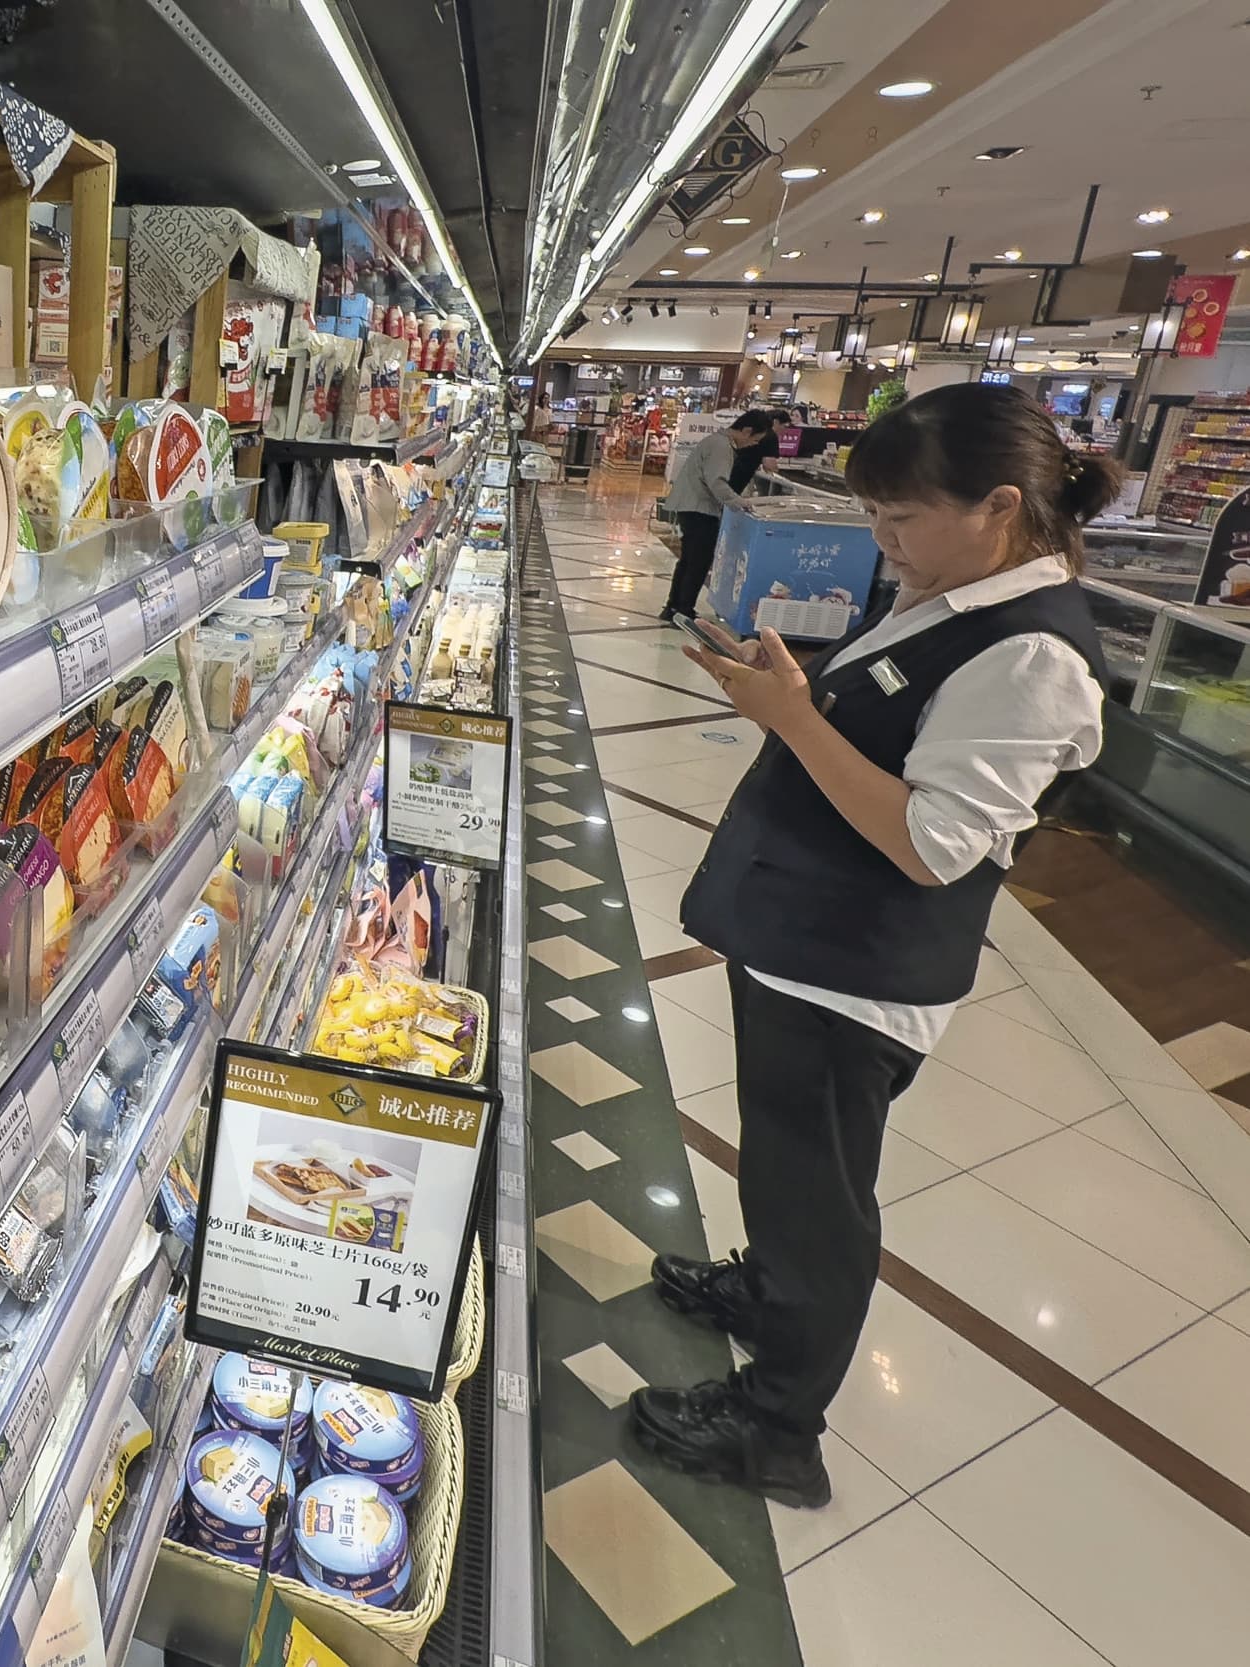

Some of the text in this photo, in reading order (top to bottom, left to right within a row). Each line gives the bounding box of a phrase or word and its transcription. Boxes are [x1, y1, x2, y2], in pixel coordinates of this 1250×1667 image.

[227, 1063, 290, 1086] HIGHLY
[225, 1079, 319, 1107] RECOMMENDED
[378, 1094, 477, 1131] 诚心推荐
[352, 1276, 441, 1314] 14.90
